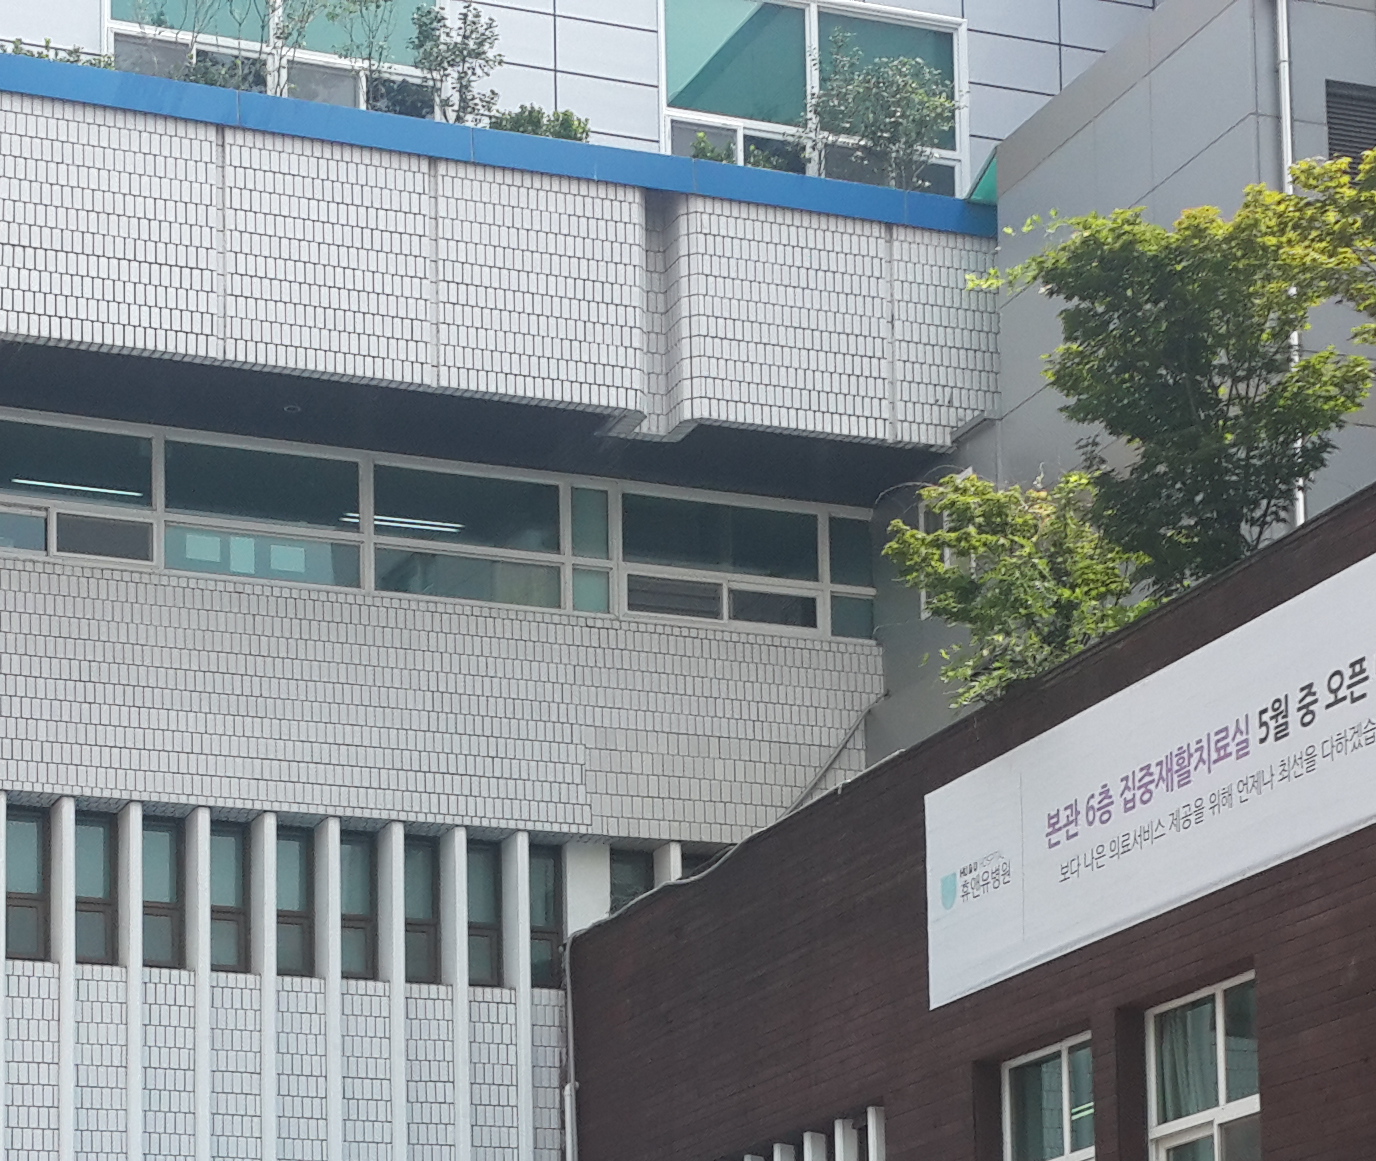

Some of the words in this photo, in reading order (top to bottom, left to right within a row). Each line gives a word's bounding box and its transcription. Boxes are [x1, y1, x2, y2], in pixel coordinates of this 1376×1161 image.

[1045, 798, 1081, 849] 본관
[1085, 782, 1115, 827] 6층
[1119, 713, 1251, 814] 집중재활치료실
[1258, 693, 1290, 745] 5월
[1296, 681, 1319, 728] 중
[1324, 655, 1370, 710] 오픈
[1059, 855, 1081, 883] 보다
[1083, 844, 1107, 871] 나은
[1168, 796, 1206, 833] 제공을
[1208, 783, 1233, 816] 위해
[1236, 764, 1275, 803] 언제나
[1277, 744, 1318, 783] 최선을
[959, 859, 1011, 903] 휴앤유병원
